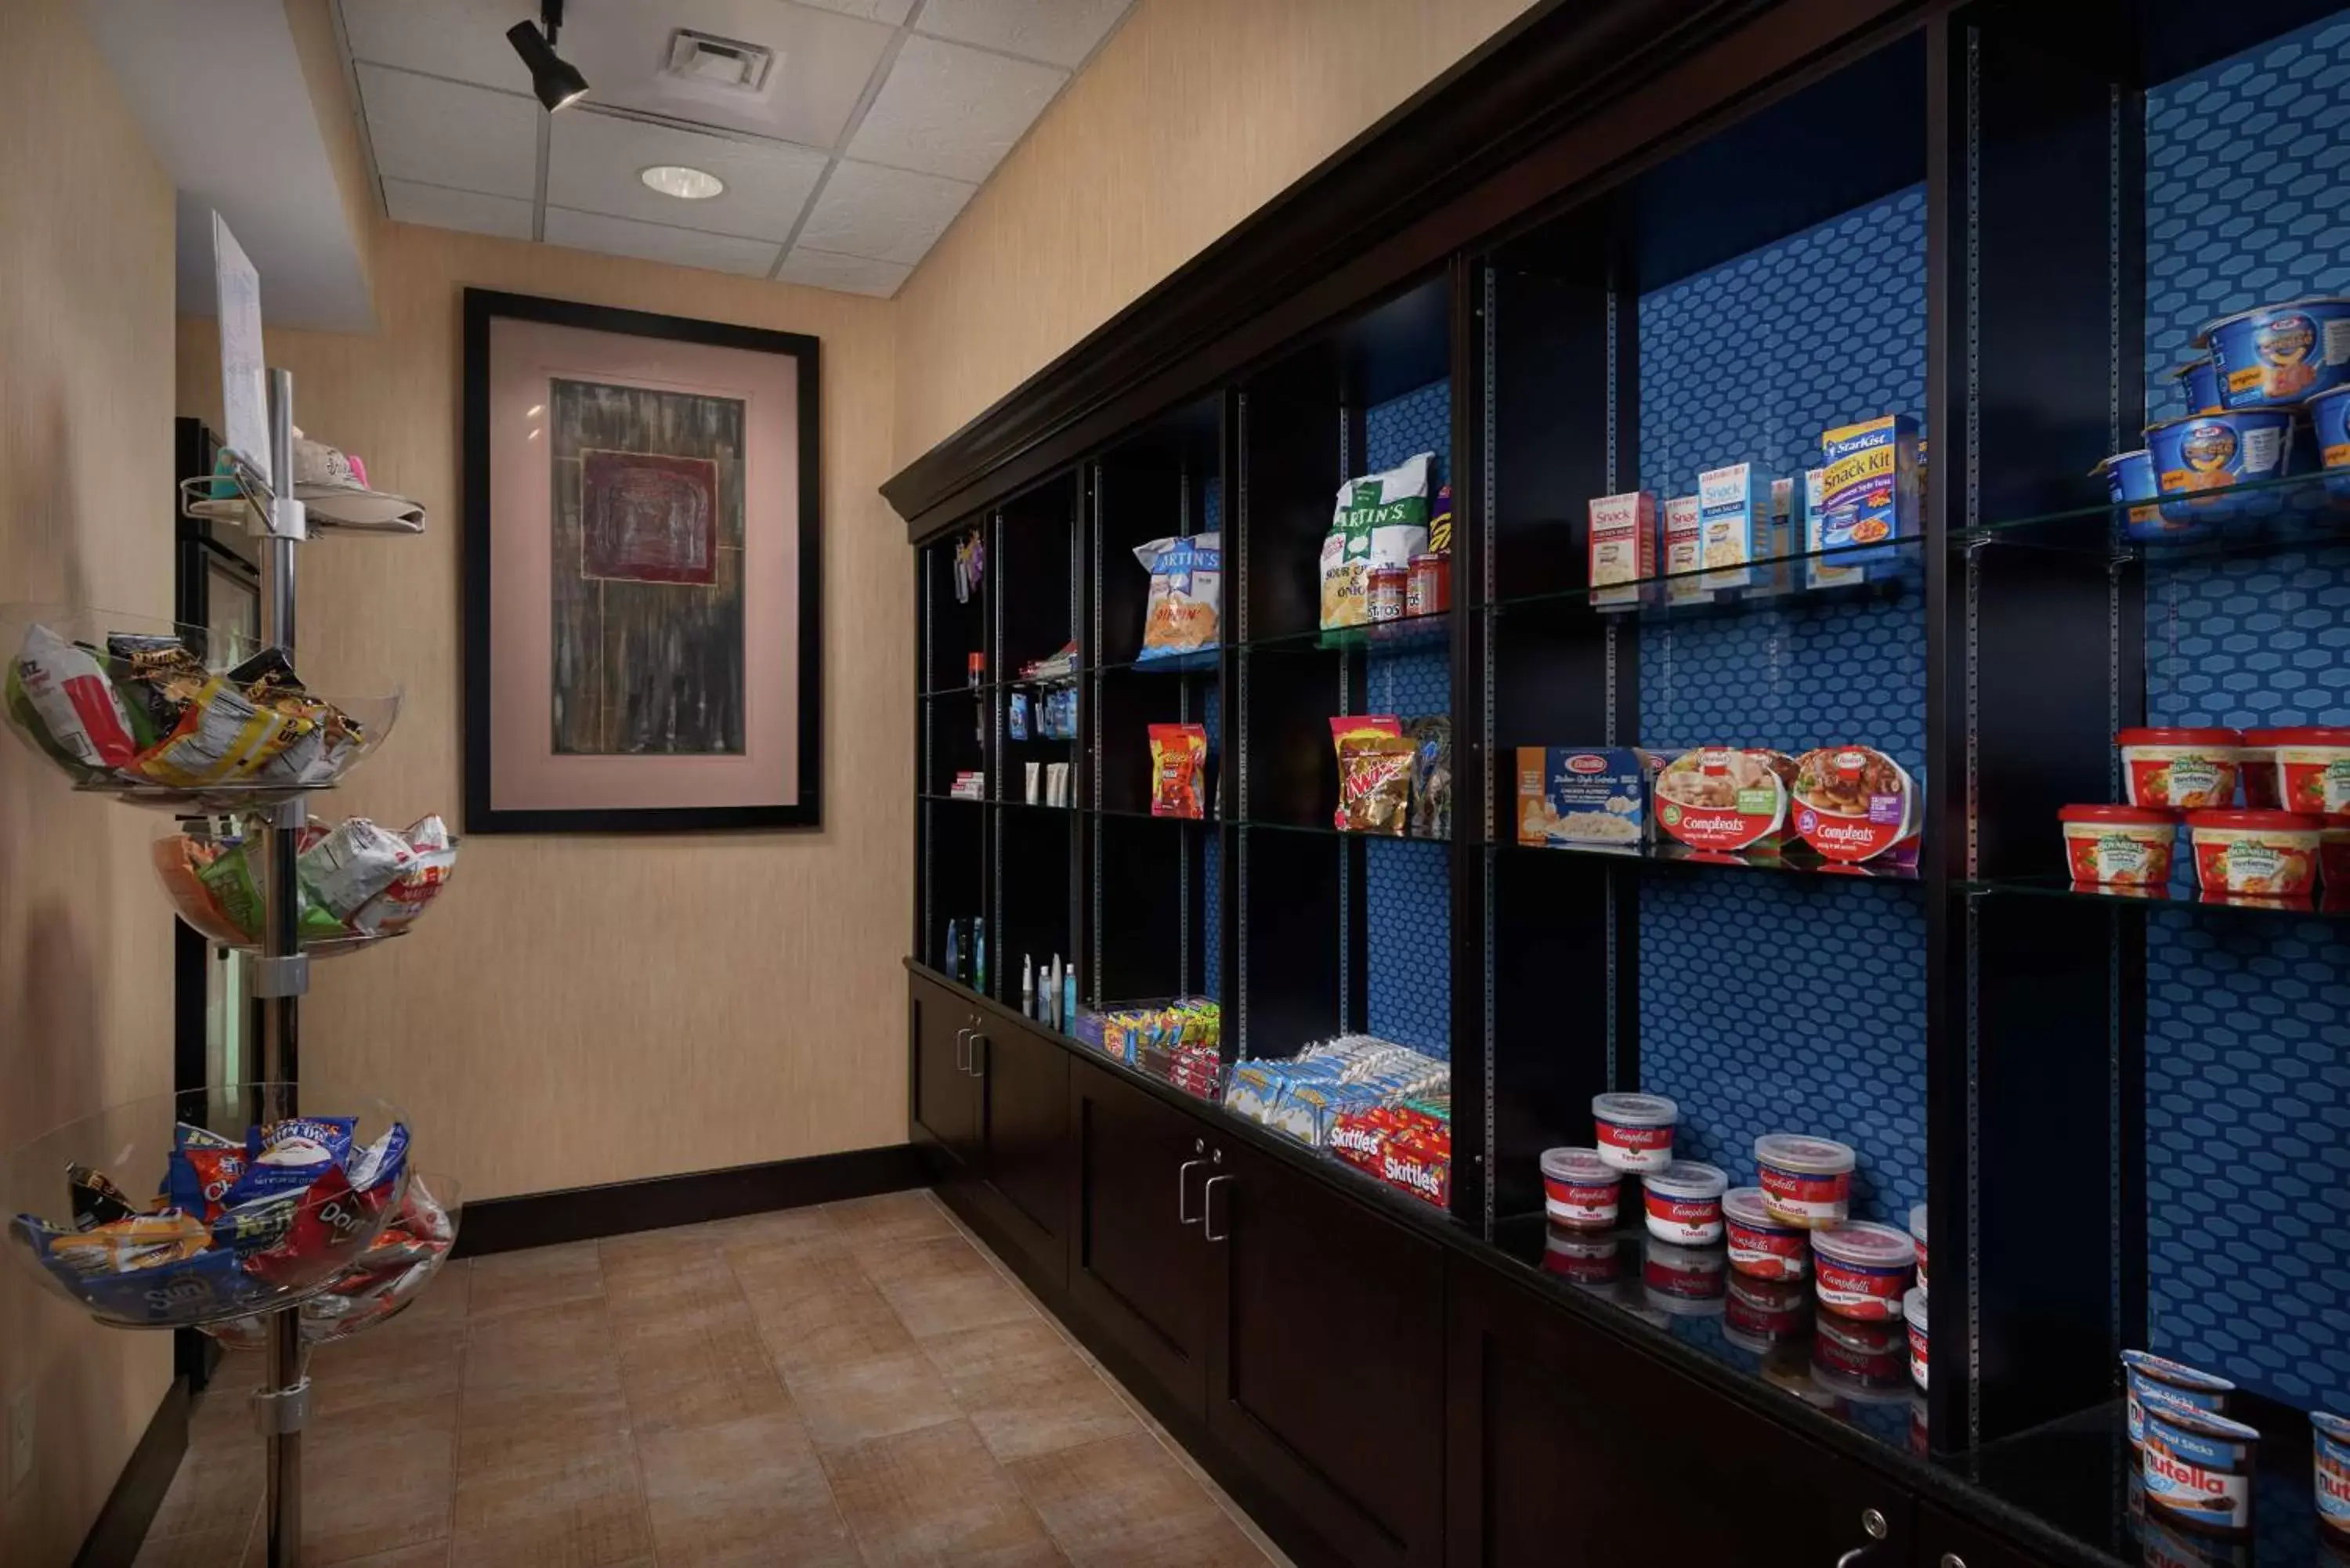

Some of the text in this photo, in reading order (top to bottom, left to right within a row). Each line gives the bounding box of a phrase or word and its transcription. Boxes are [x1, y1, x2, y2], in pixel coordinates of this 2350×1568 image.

[1838, 434, 1885, 453] StarKist
[1824, 452, 1890, 492] Snack Kit
[1596, 509, 1630, 523] Snack
[1673, 512, 1697, 523] Snac
[1337, 586, 1366, 598] ONIO
[1683, 815, 1744, 833] Compleats
[1817, 824, 1873, 843] Compleats
[1329, 1126, 1378, 1155] Skittles
[1385, 1156, 1439, 1196] Skittles
[1822, 1268, 1871, 1292] Campbell's
[2181, 1439, 2214, 1457] Sticks
[2145, 1450, 2225, 1494] nutella
